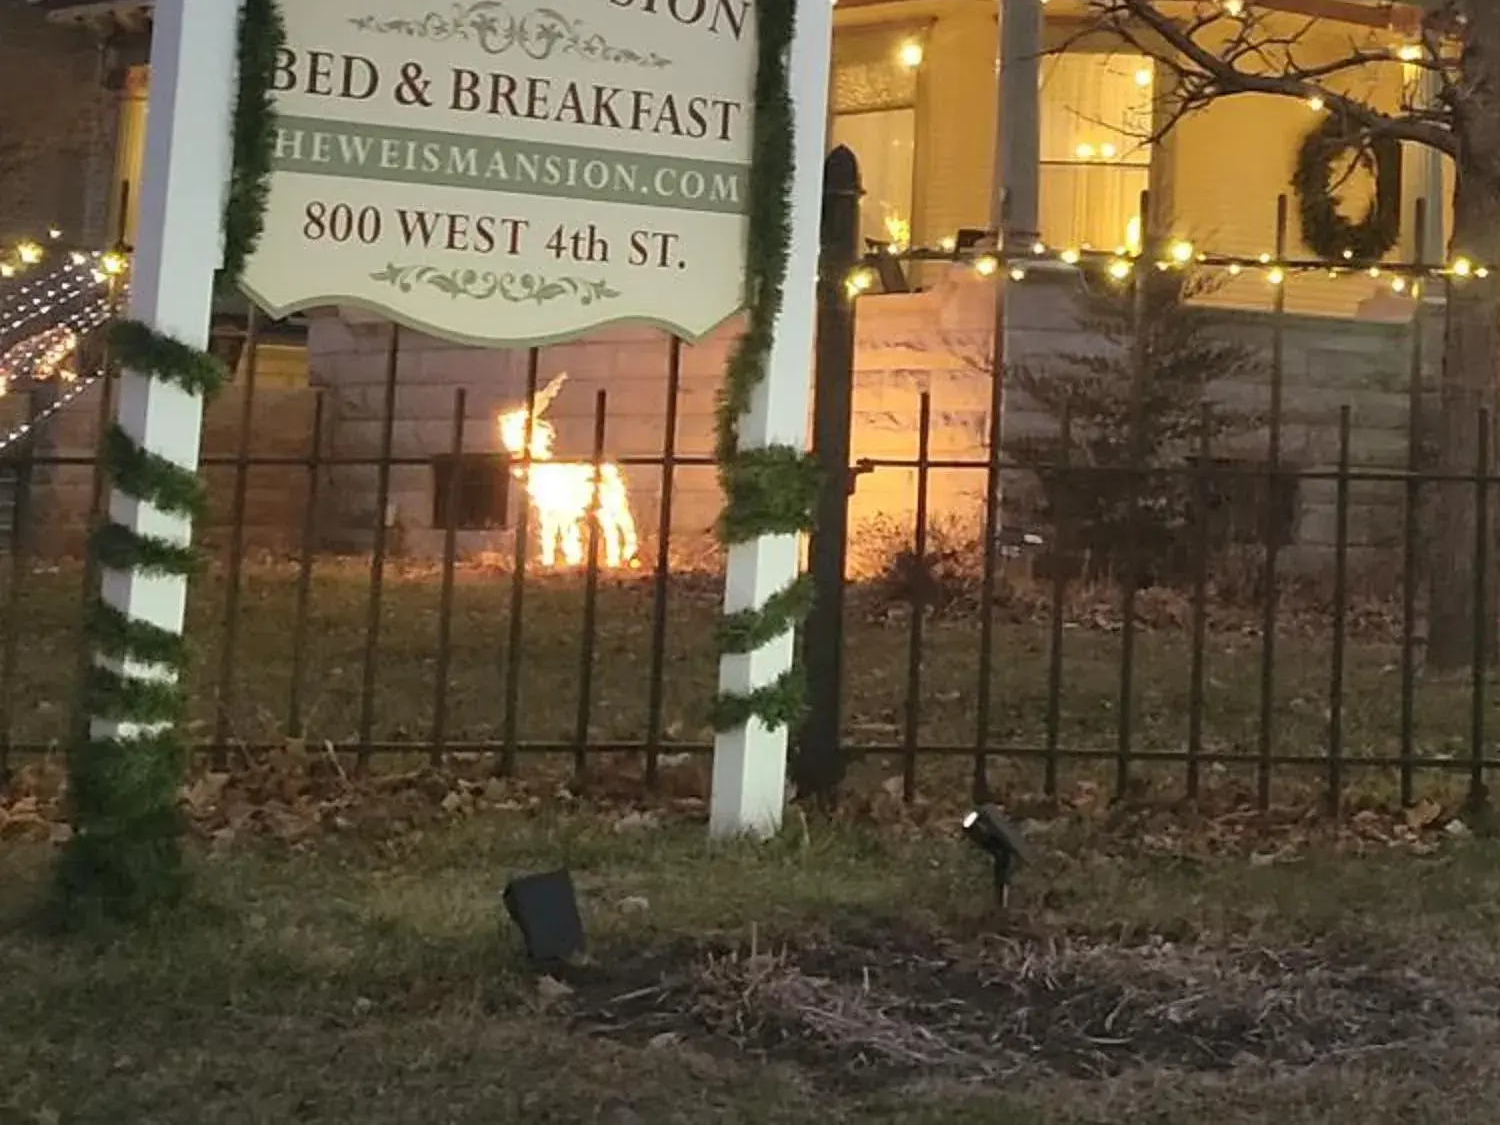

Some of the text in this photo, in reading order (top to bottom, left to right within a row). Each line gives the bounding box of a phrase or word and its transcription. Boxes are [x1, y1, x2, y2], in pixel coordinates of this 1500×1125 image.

[270, 48, 741, 141] BED & BREAKFAST
[268, 128, 740, 203] HEWEISMANSION.COM
[303, 201, 687, 269] 800 WEST 4th ST.
